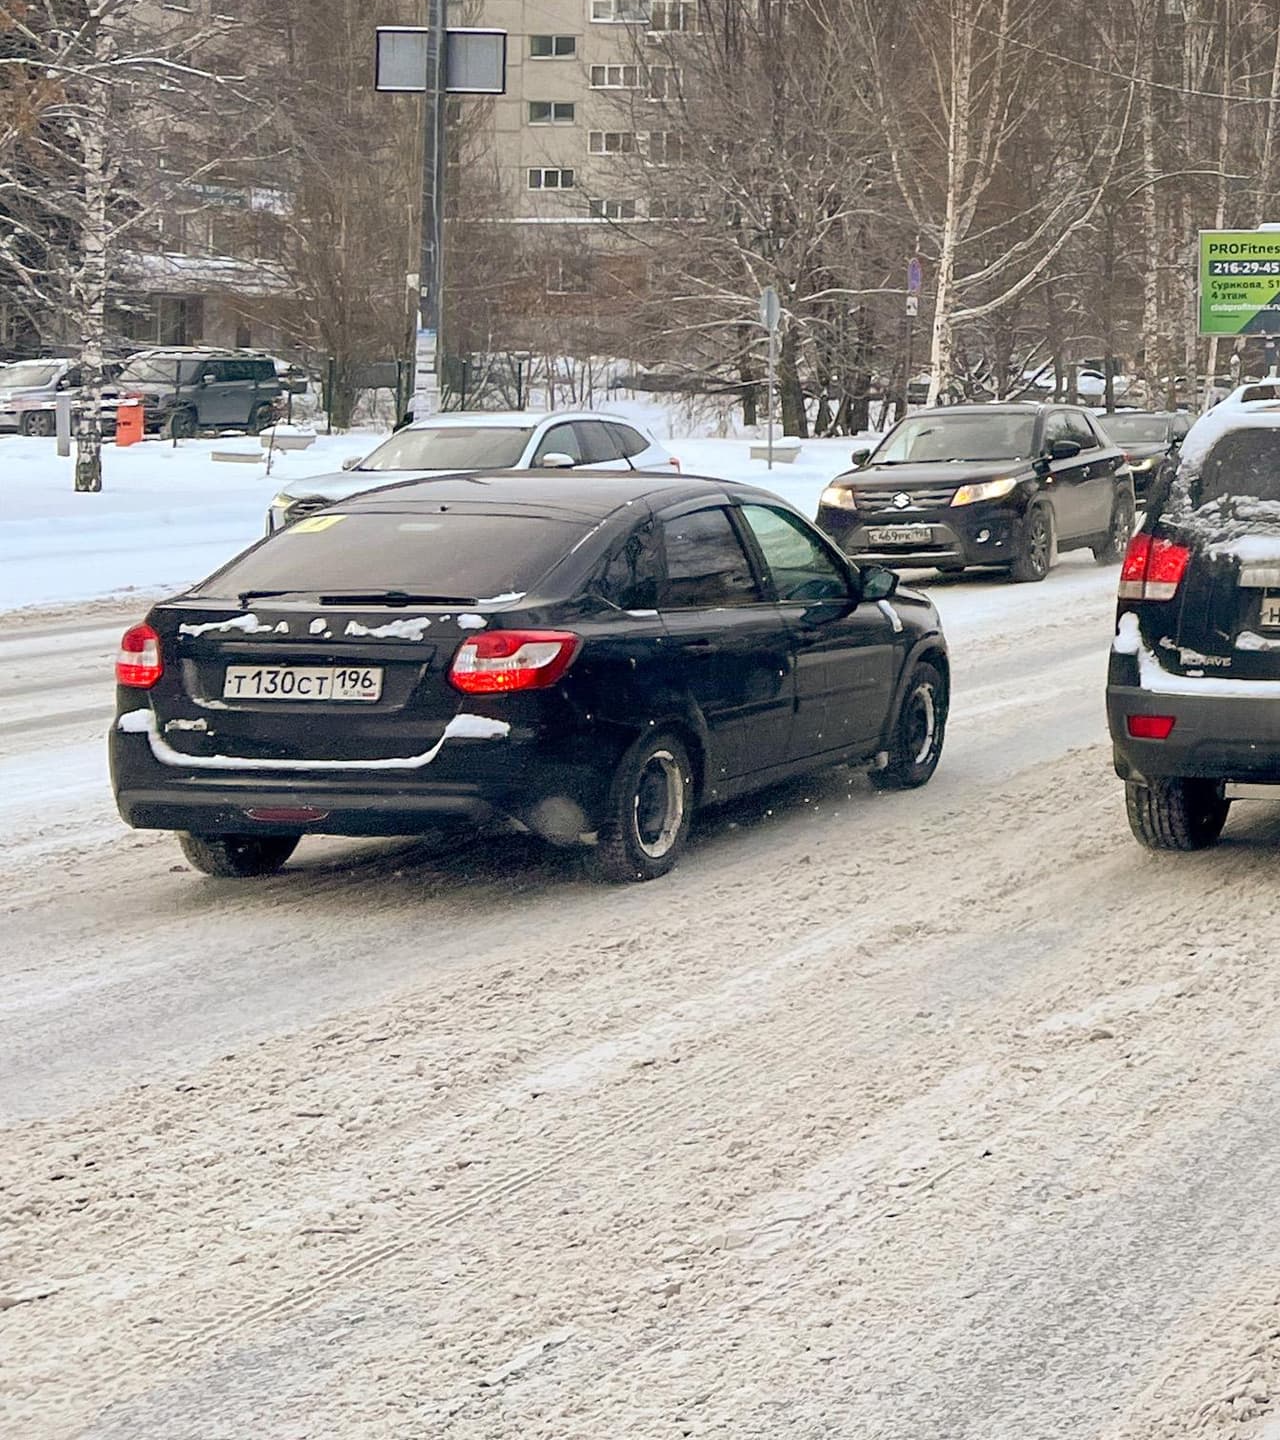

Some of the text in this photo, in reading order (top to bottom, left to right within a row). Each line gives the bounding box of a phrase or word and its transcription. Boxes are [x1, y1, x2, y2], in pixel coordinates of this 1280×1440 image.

[1214, 262, 1280, 273] 216-29-45
[1211, 280, 1264, 291] Сурикова,
[1211, 292, 1247, 300] 4 этаж
[234, 670, 374, 695] Т130СТ 196
